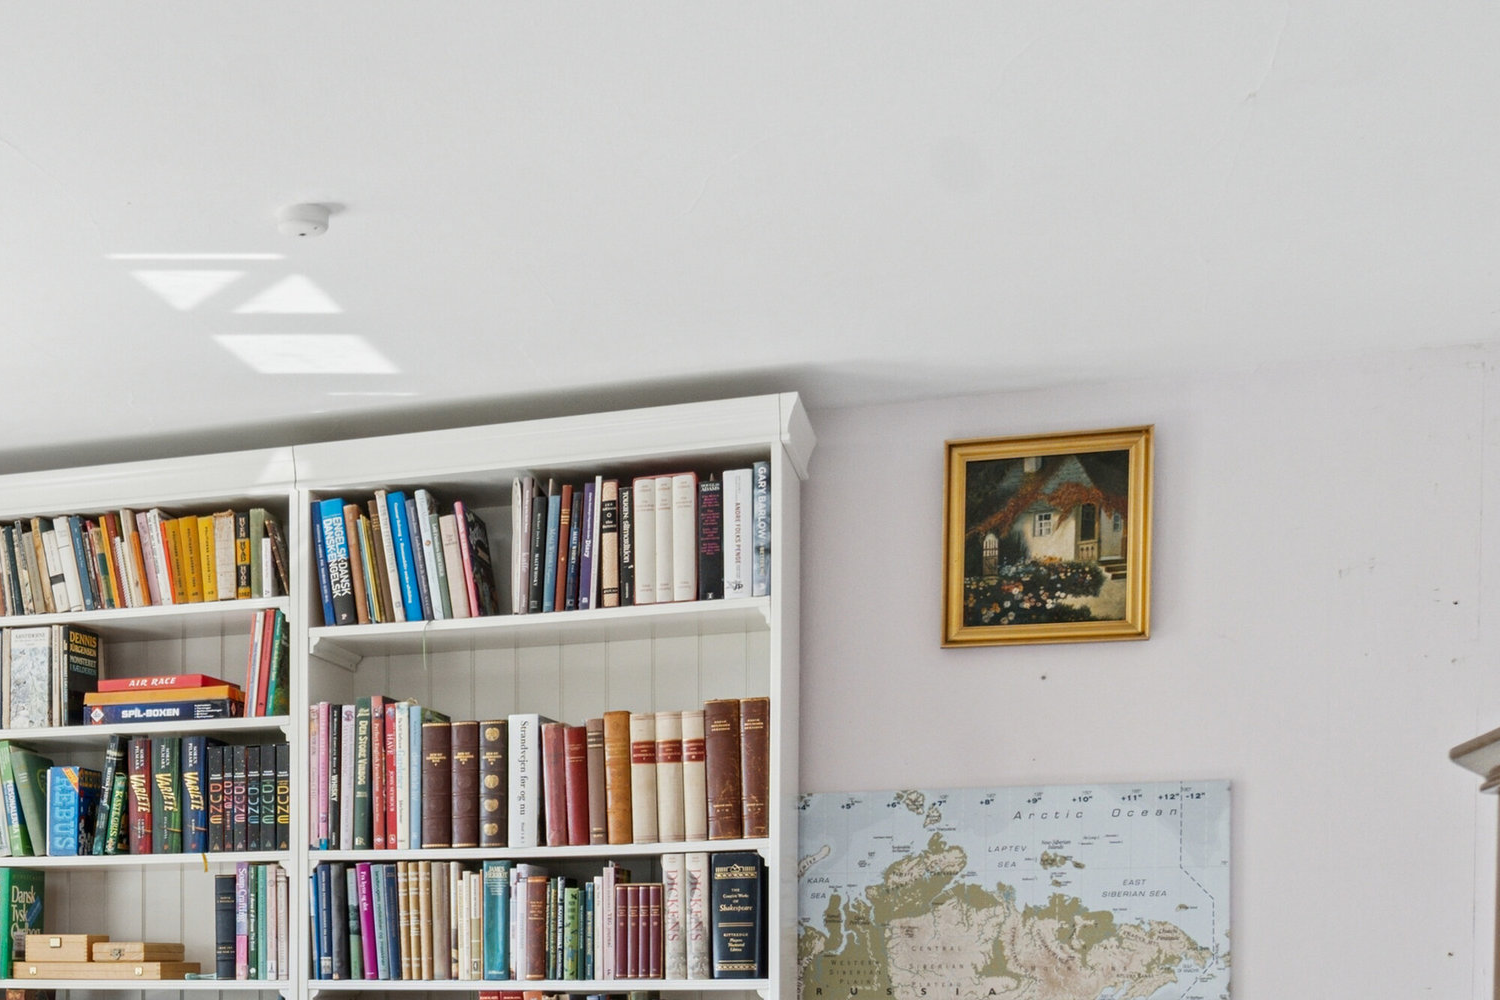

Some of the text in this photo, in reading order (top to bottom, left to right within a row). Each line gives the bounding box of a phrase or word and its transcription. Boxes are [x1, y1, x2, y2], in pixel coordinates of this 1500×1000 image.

[757, 467, 766, 539] GARY BARLOW
[584, 539, 592, 558] Diary
[69, 630, 97, 648] DENNIS
[151, 677, 176, 685] RACE
[358, 720, 367, 785] DEN STORE VINBOG
[518, 721, 529, 773] Strandvejen
[518, 790, 525, 801] og
[54, 777, 76, 849] REBUS
[519, 803, 525, 816] nu
[1013, 808, 1178, 820] Arctic Ocean
[988, 845, 1028, 853] LAPTEV
[997, 861, 1017, 869] SEA
[12, 885, 36, 904] Dansk
[236, 868, 247, 923] Soap Crafting
[810, 892, 826, 900] SEA
[11, 903, 28, 922] Tysk
[667, 870, 680, 941] DICKENS
[690, 869, 703, 941] DICKENS
[719, 904, 753, 912] Shakespeare
[816, 987, 997, 996] RUSSIA
